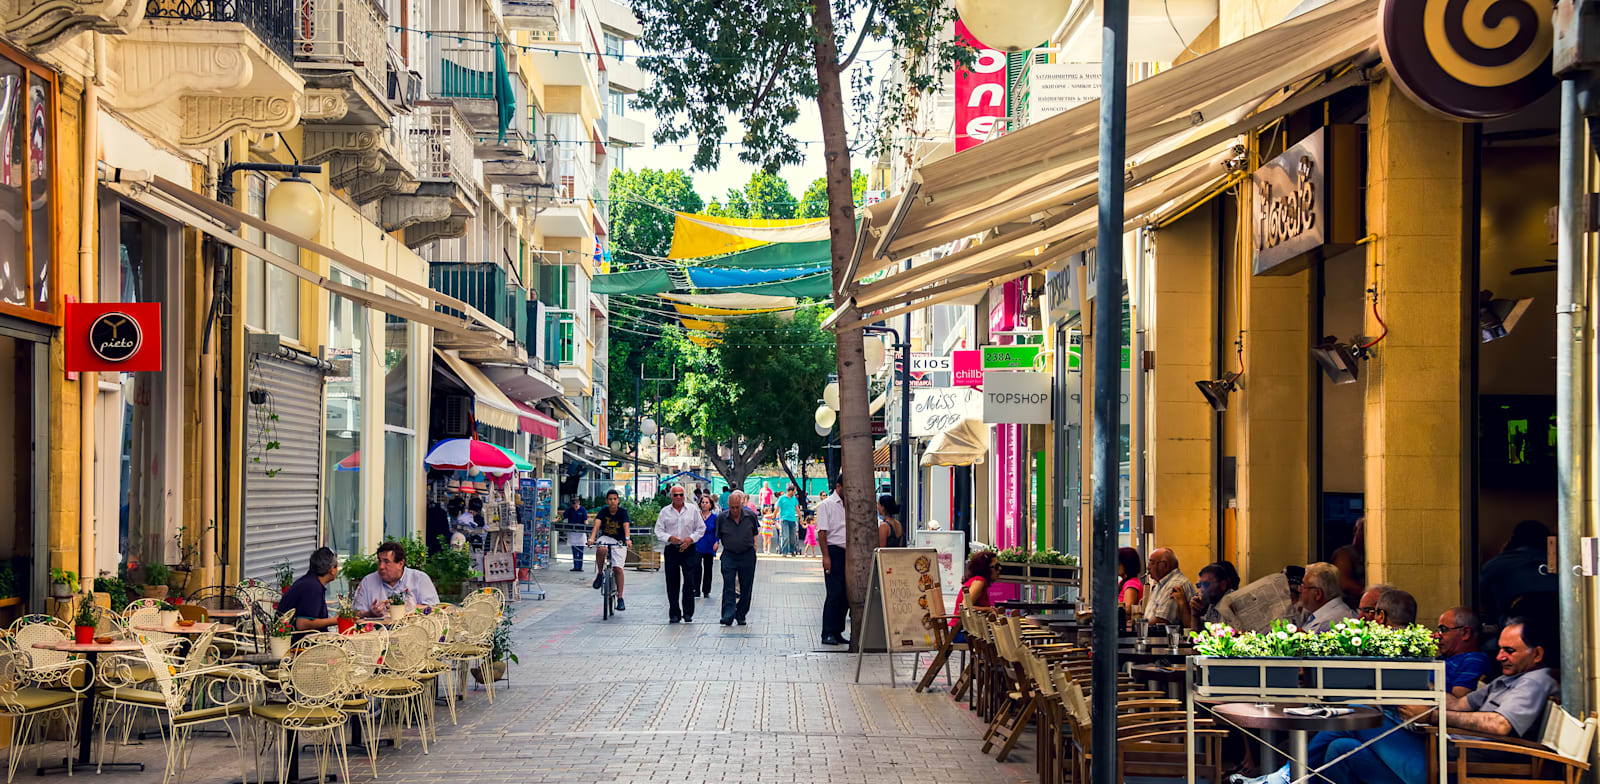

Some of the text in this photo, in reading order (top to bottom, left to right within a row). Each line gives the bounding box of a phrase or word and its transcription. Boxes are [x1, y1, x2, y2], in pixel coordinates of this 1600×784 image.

[99, 338, 134, 353] pieto
[913, 359, 950, 369] KIOS
[987, 392, 1049, 404] TOPSHOP
[890, 588, 912, 600] MOOD
[892, 602, 913, 615] FOOD
